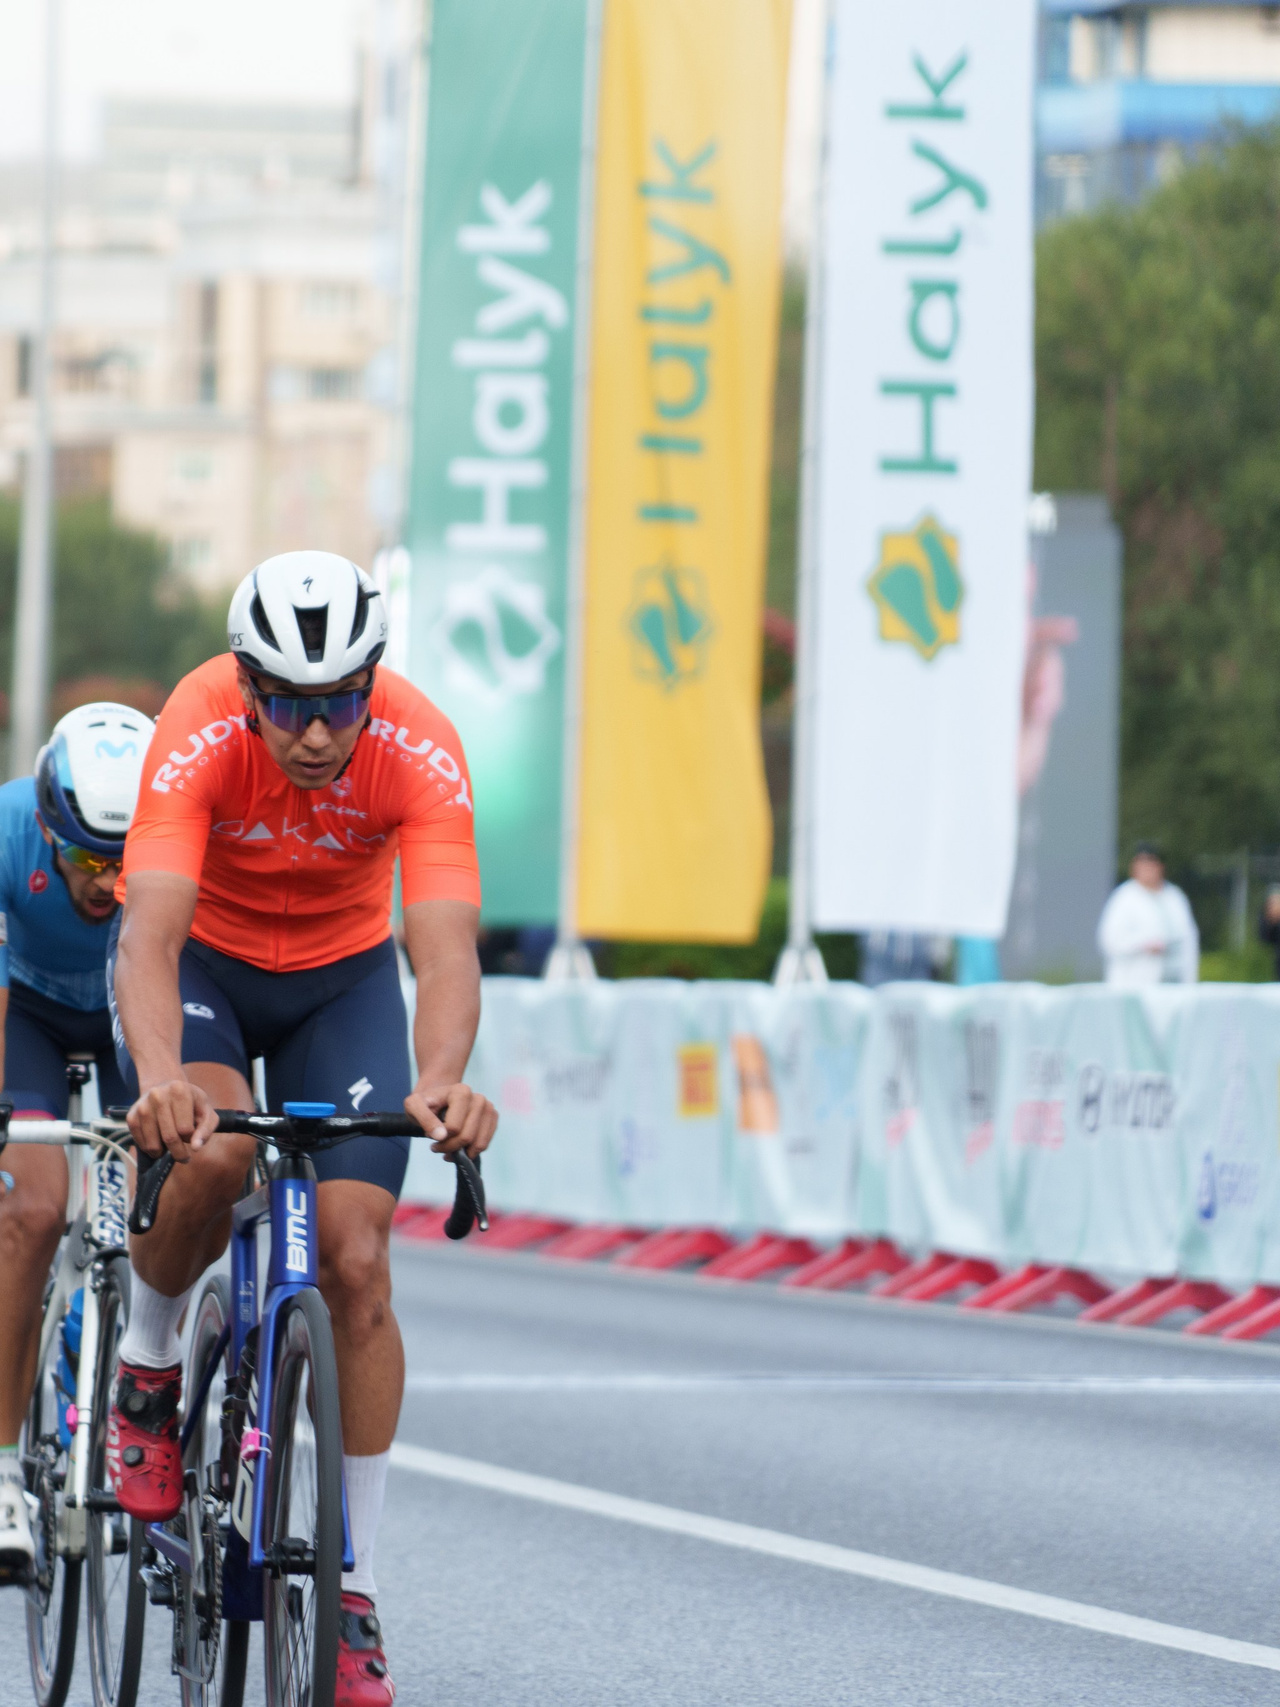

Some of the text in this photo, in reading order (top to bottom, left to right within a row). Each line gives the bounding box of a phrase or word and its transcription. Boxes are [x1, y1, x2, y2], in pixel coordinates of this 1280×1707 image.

[445, 178, 569, 553] Halyk
[637, 135, 732, 523] Halyk
[877, 46, 989, 476] Halyk
[151, 713, 247, 793] RUDY
[368, 717, 472, 812] RUDY
[285, 1187, 308, 1274] BMC
